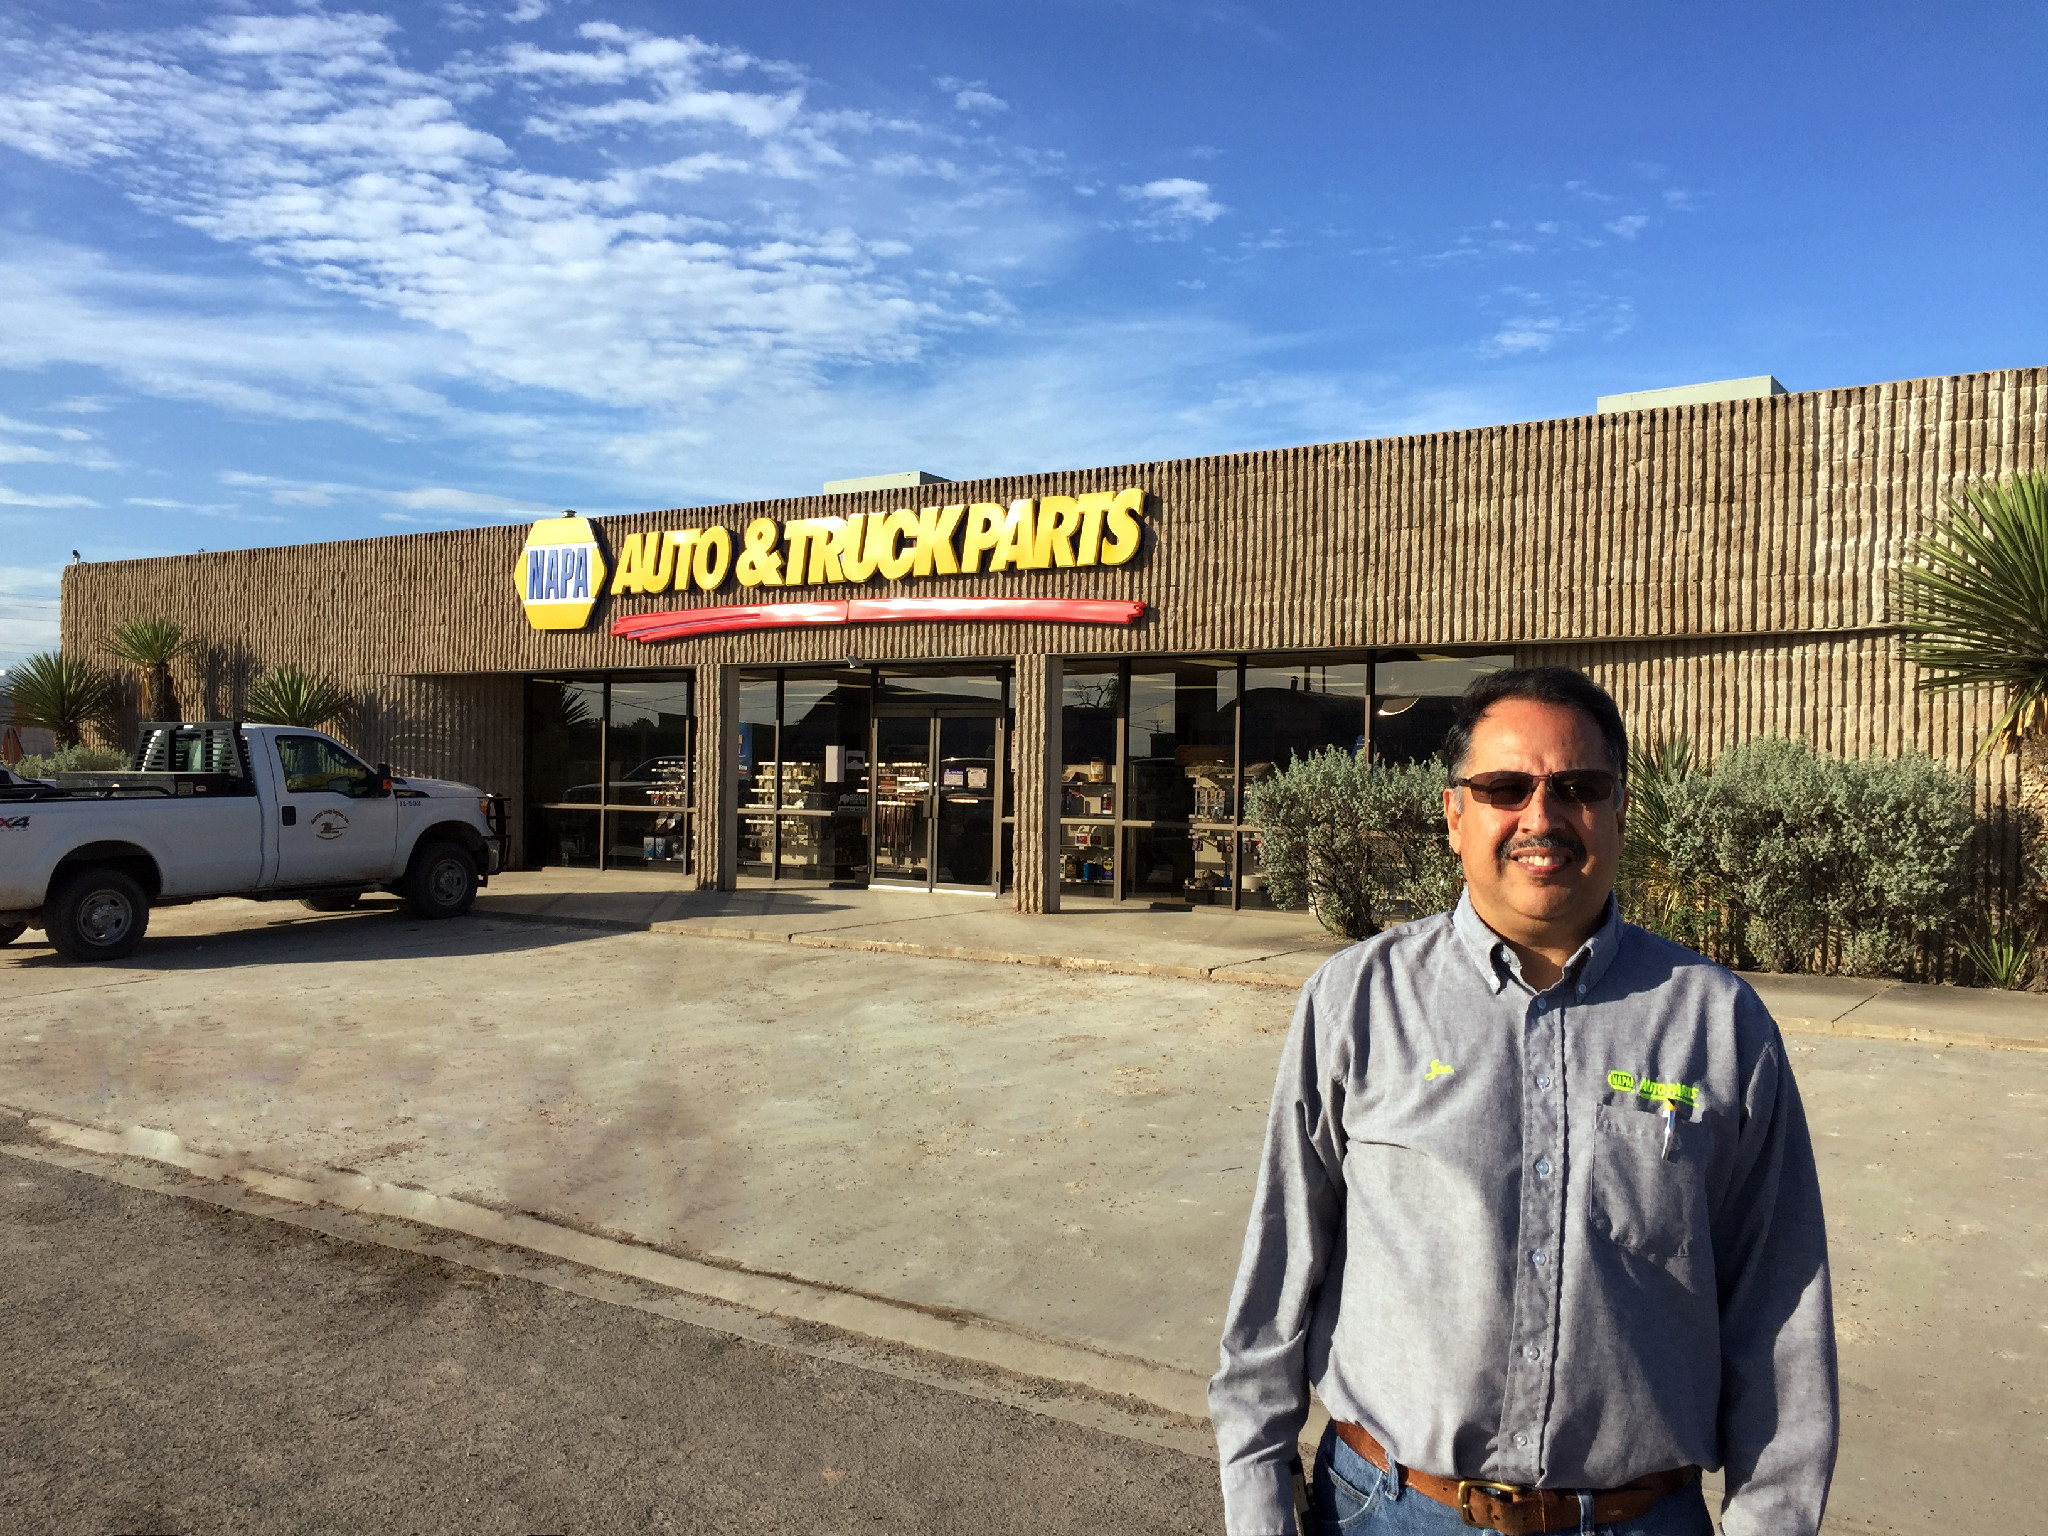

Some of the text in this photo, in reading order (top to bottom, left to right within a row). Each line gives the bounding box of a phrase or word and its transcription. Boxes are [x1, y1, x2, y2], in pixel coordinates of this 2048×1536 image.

[528, 547, 588, 599] NAPA
[610, 525, 733, 595] AUTO
[735, 517, 785, 587] &
[1610, 1073, 1634, 1089] NAPA
[1640, 1078, 1667, 1096] AUTO
